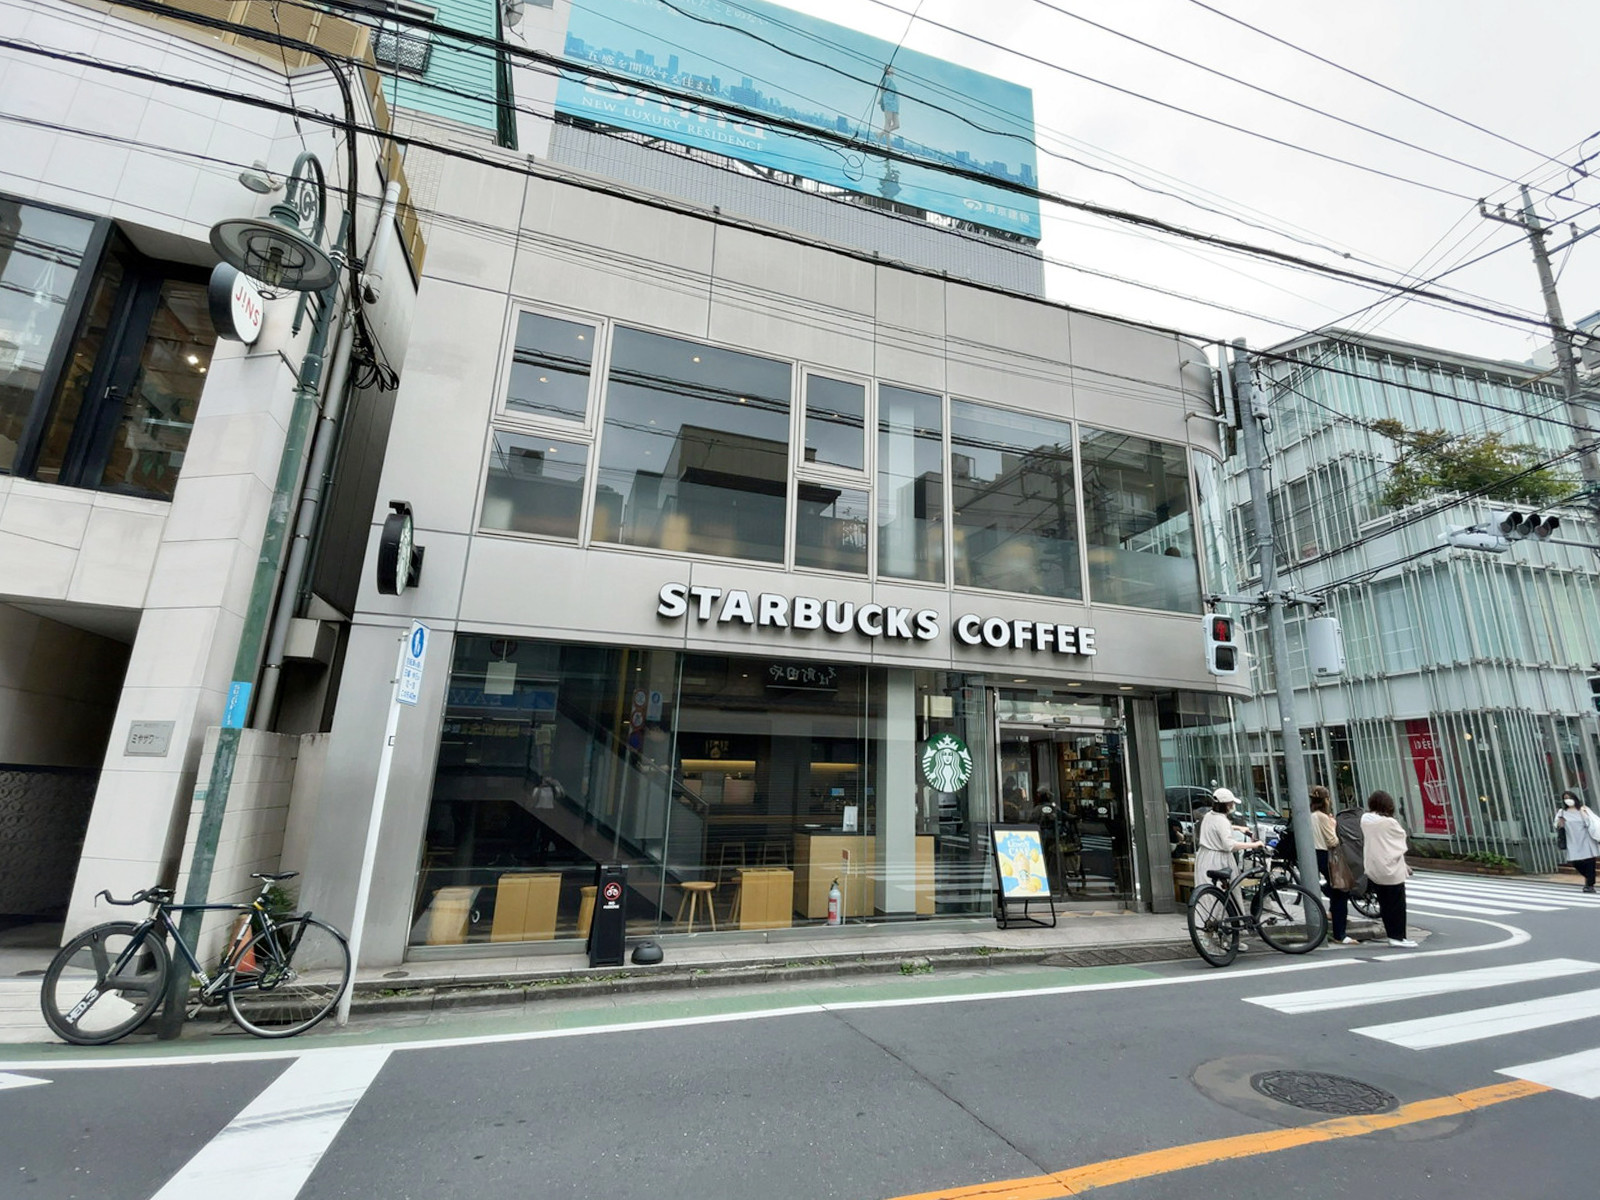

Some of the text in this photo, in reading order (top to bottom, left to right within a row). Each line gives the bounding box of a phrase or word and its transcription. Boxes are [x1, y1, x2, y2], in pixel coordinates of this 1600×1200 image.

[582, 96, 763, 151] NEW LUXURY RESIDENCE
[657, 581, 1098, 656] STARBUCKS COFFEE
